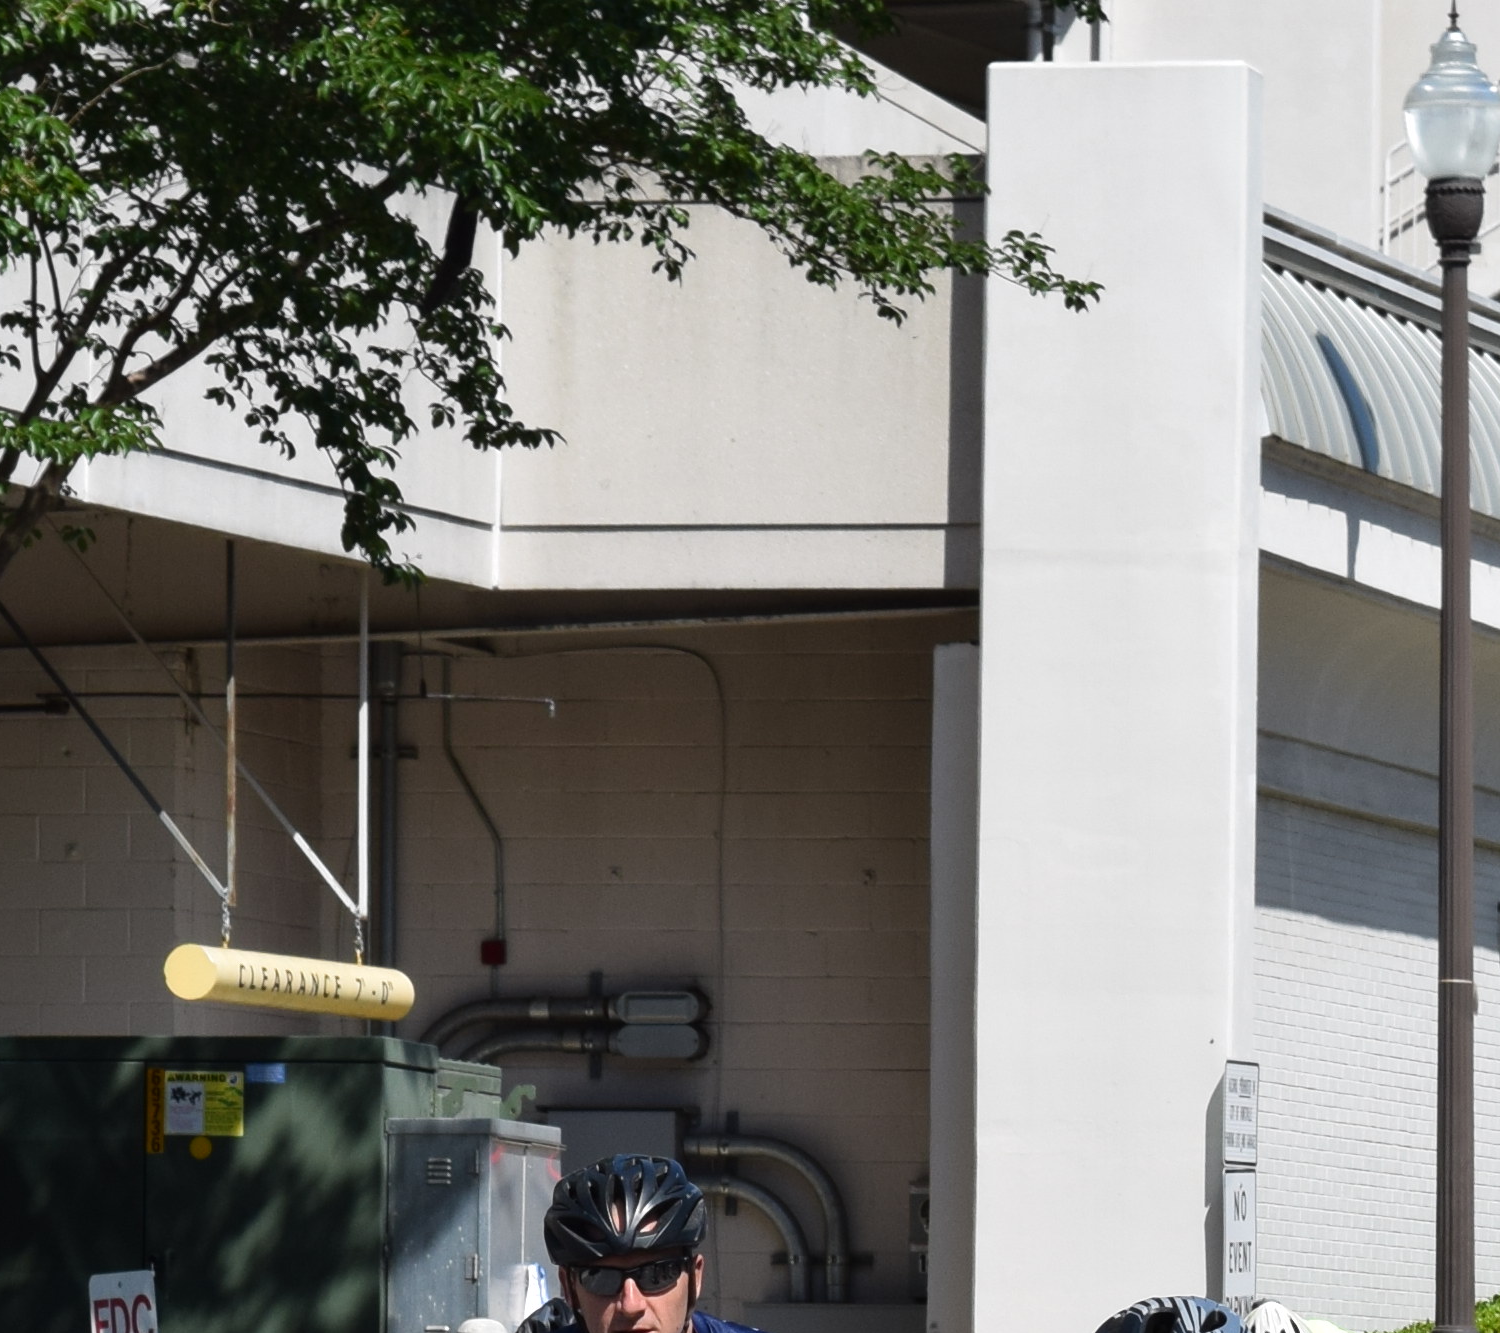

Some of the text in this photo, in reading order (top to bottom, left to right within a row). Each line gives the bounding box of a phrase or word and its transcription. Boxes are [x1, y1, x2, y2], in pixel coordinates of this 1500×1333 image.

[238, 963, 342, 999] CLEARANCE
[175, 1073, 227, 1083] WARNING
[1232, 1190, 1248, 1222] NO
[1229, 1241, 1252, 1274] EVENT
